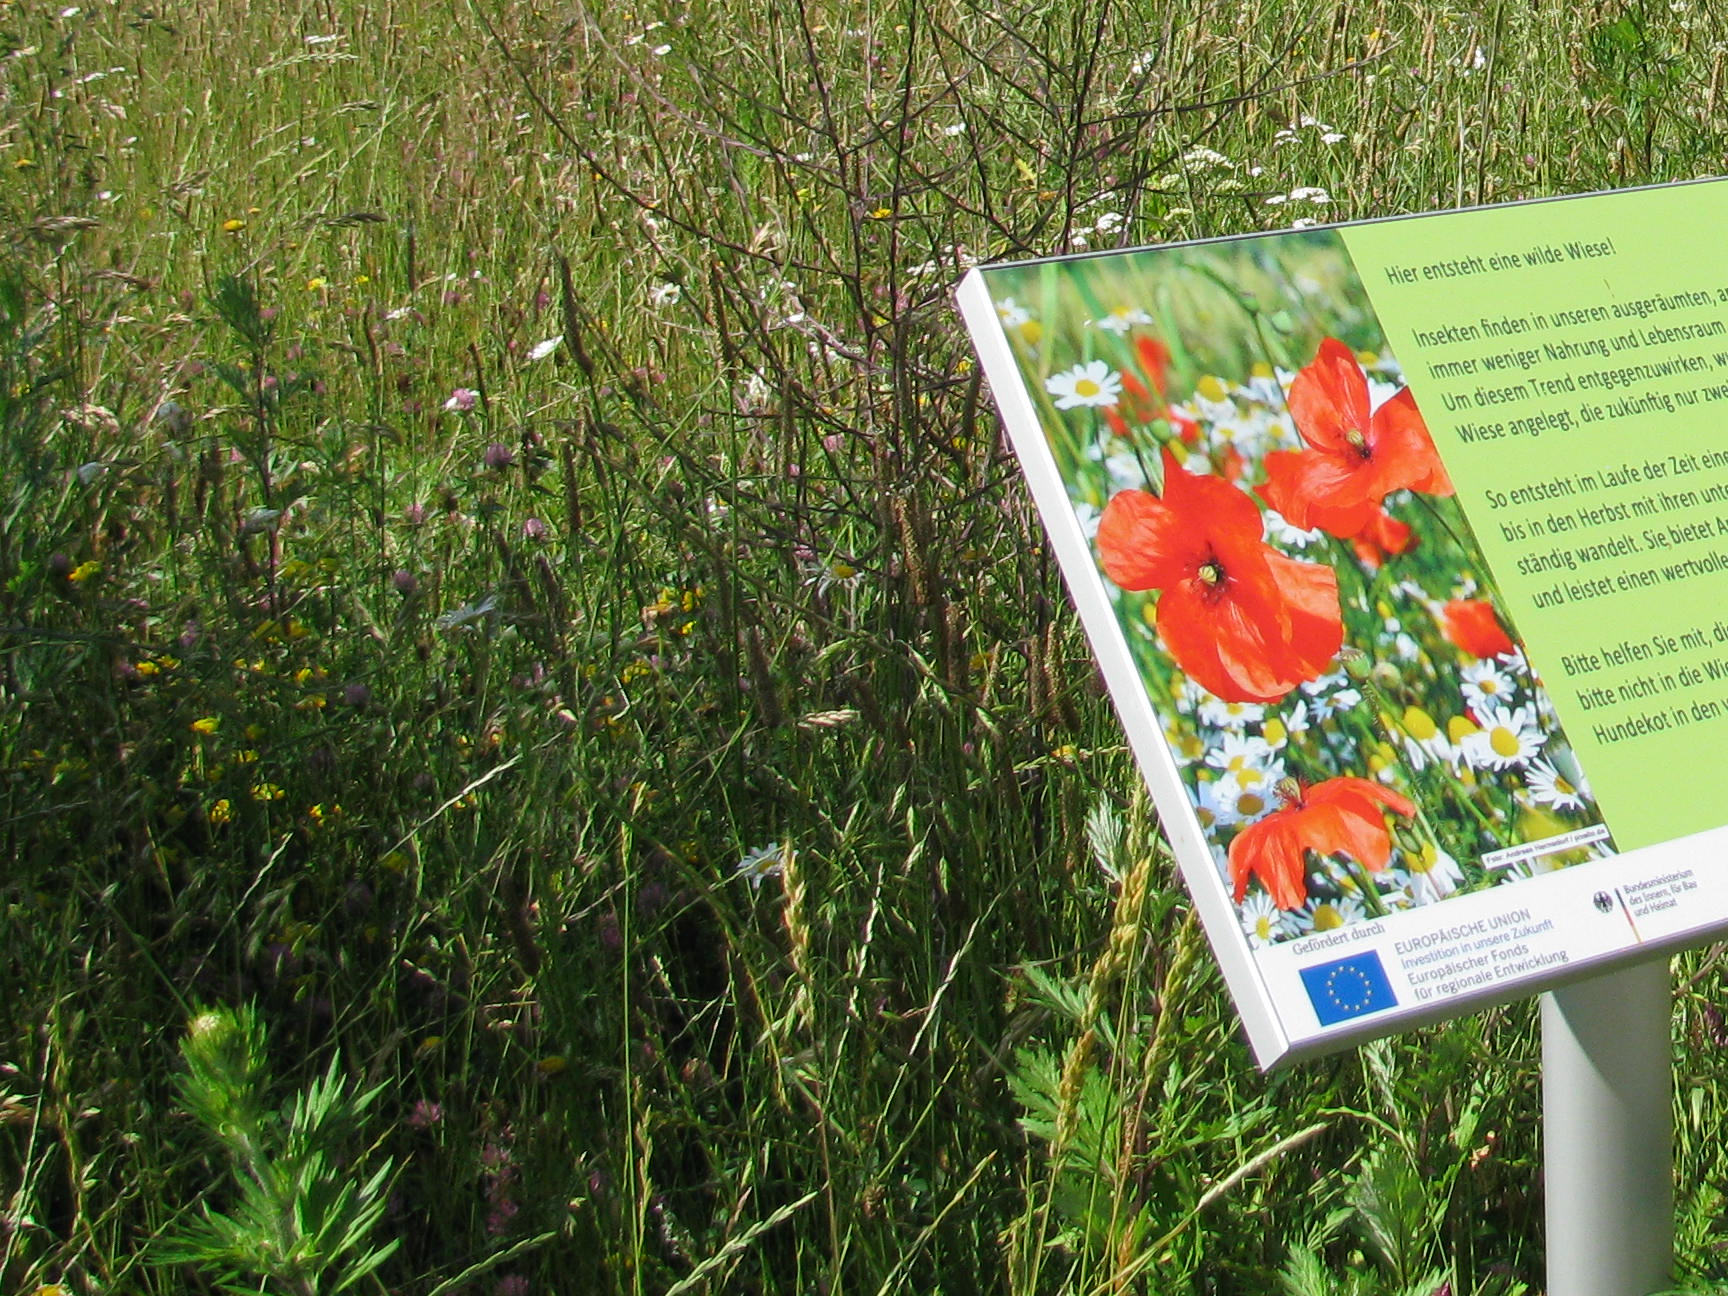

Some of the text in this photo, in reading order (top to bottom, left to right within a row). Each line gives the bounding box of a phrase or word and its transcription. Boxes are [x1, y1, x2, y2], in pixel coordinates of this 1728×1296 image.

[1385, 237, 1617, 285] Hier entsteht eine wilde Wiese!
[1412, 325, 1481, 348] Insekten
[1481, 316, 1532, 338] finden
[1530, 313, 1549, 331] in
[1550, 307, 1611, 328] unseren
[1611, 291, 1717, 320] ausgeräumten,
[1427, 359, 1479, 380] immer
[1481, 348, 1542, 372] weniger
[1543, 339, 1611, 362] Nahrung
[1610, 329, 1641, 352] und
[1441, 393, 1473, 412] Um
[1474, 386, 1530, 407] diesem
[1528, 373, 1576, 398] Trend
[1578, 354, 1714, 391] entgegenzuwirken,
[1455, 423, 1507, 444] Wiese
[1508, 409, 1580, 437] angelegt,
[1580, 403, 1606, 423] die
[1606, 392, 1676, 419] zukünftig
[1674, 390, 1700, 407] nur
[1486, 490, 1508, 510] So
[1510, 477, 1577, 505] entsteht
[1575, 474, 1599, 493] im
[1597, 464, 1643, 489] Laufe
[1643, 460, 1668, 481] der
[1668, 454, 1702, 476] Zeit
[1500, 521, 1527, 543] bis
[1525, 519, 1546, 538] in
[1547, 513, 1578, 534] den
[1576, 502, 1632, 528] Herbst
[1631, 496, 1660, 518] mit
[1657, 492, 1700, 512] ihren
[1517, 548, 1578, 576] ständig
[1575, 534, 1644, 564] wandelt.
[1643, 530, 1672, 551] Sie
[1667, 520, 1716, 545] bietet
[1533, 584, 1565, 609] und
[1563, 576, 1617, 602] leistet
[1617, 570, 1661, 592] einen
[1562, 654, 1602, 677] Bitte
[1600, 642, 1654, 668] helfen
[1653, 635, 1680, 657] Sie
[1680, 628, 1713, 650] mit,
[1576, 688, 1618, 711] bitte
[1618, 676, 1660, 702] nicht
[1657, 672, 1678, 692] in
[1679, 666, 1704, 688] die
[1592, 711, 1673, 745] Hundekot
[1670, 707, 1690, 727] in
[1691, 700, 1722, 722] den
[1623, 870, 1694, 895] Bundesministerium
[1630, 881, 1698, 906] des Innern, für Bau
[1635, 899, 1678, 917] und Heimat
[1293, 923, 1386, 955] Gefördert durch
[1395, 910, 1531, 955] EUROPÄISCHE UNION
[1401, 920, 1554, 970] Investition in unsere Zukunft
[1408, 945, 1529, 986] Europäischer Fonds
[1415, 951, 1570, 1001] für regionale Entwicklung
